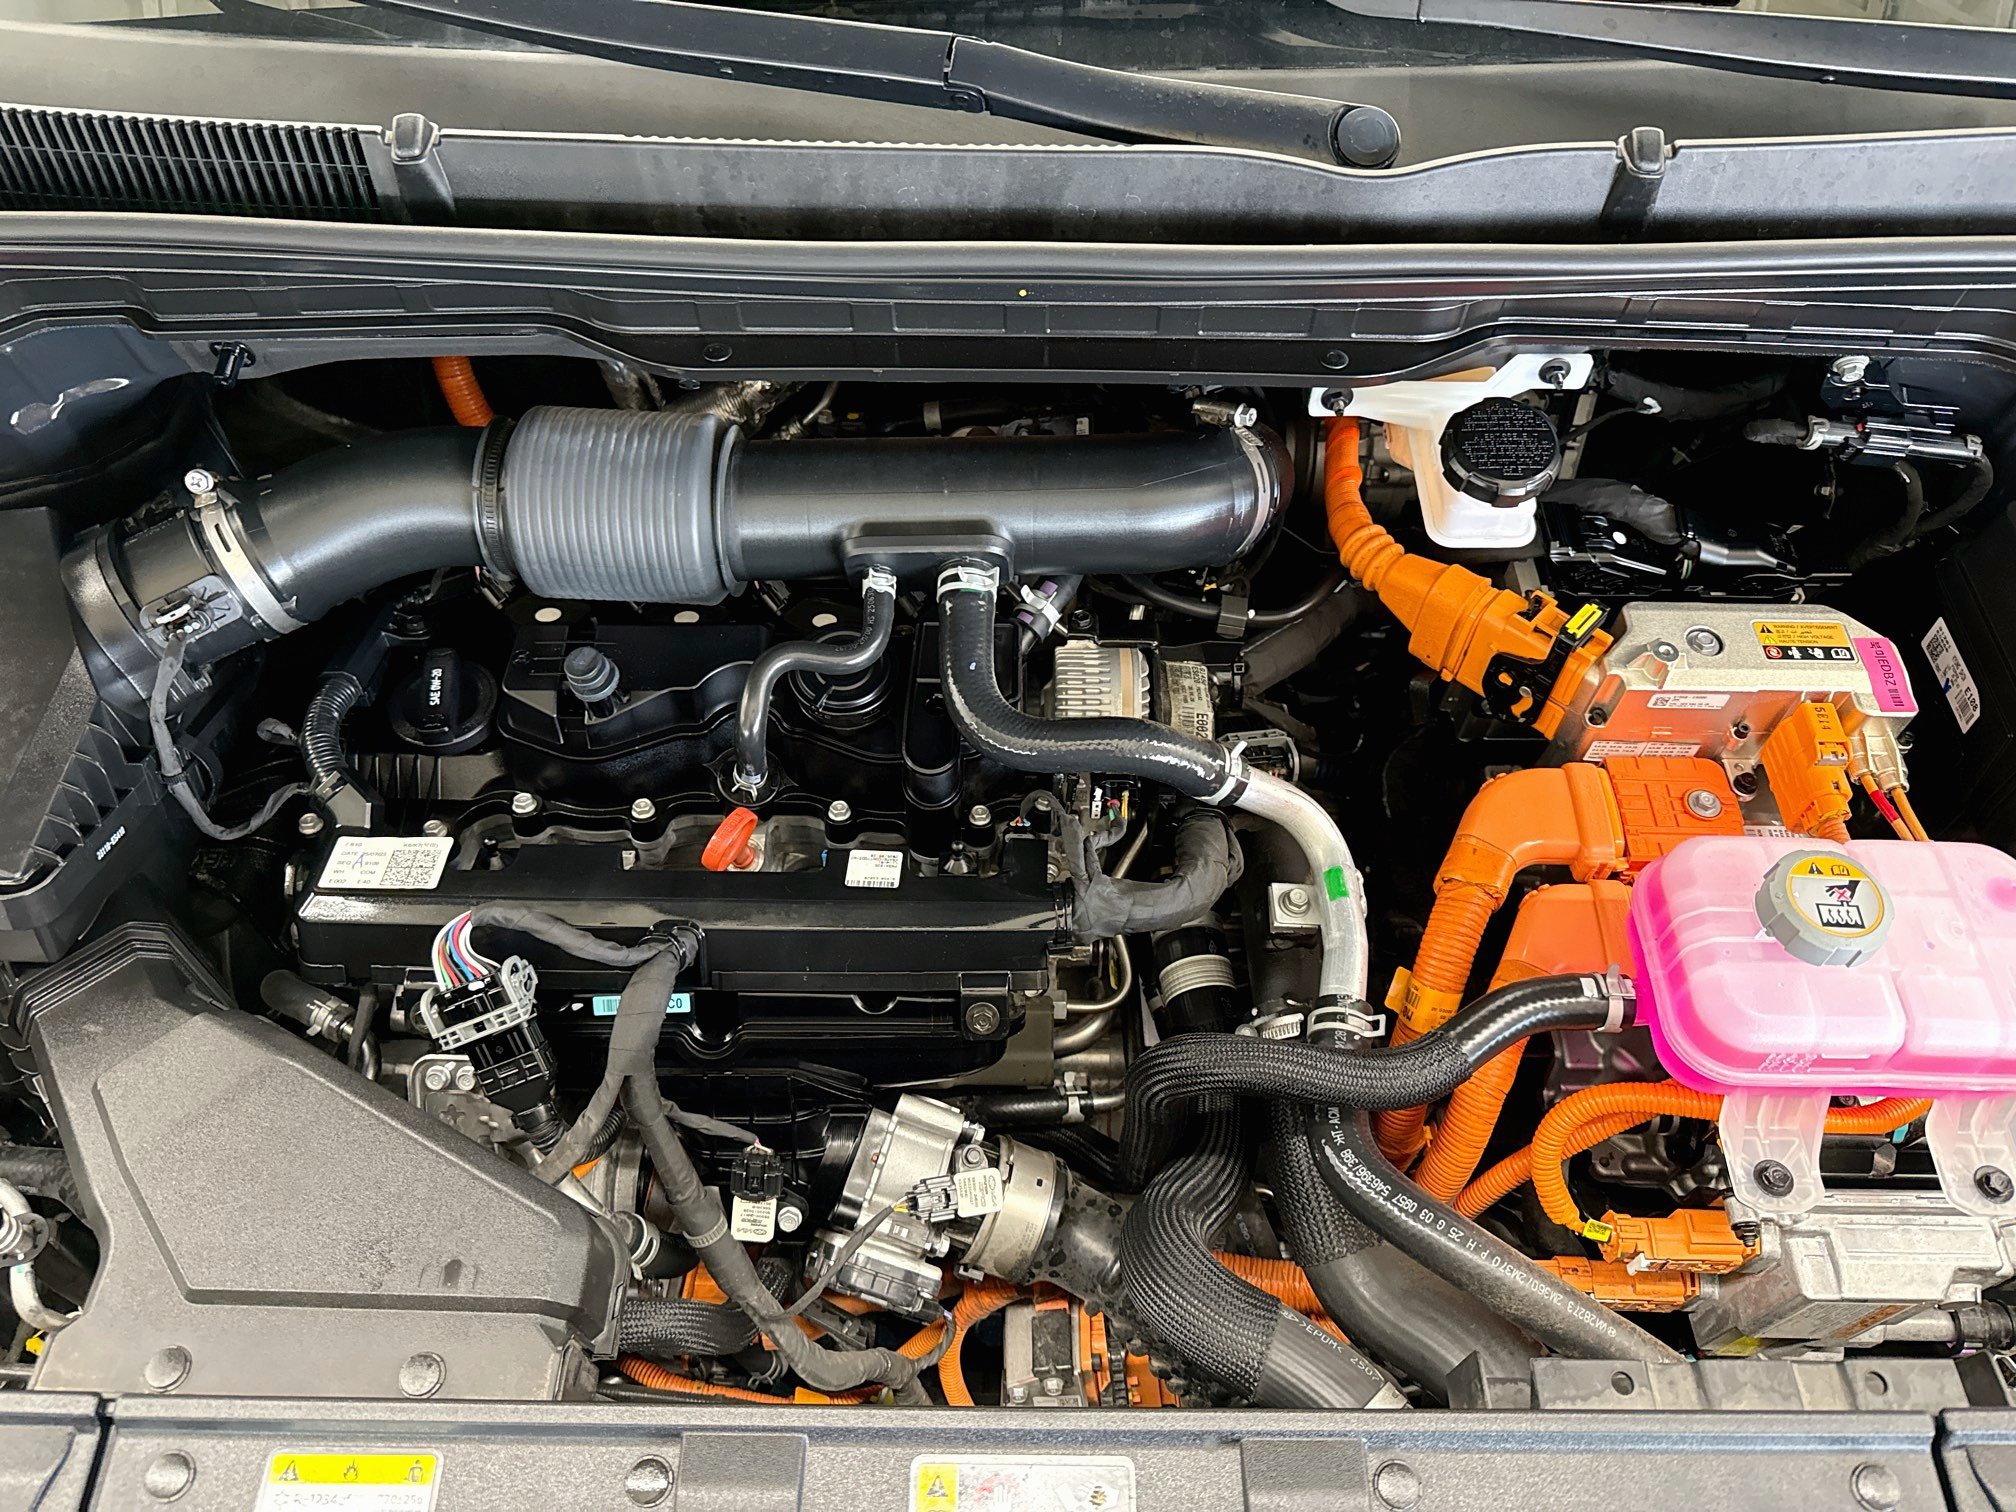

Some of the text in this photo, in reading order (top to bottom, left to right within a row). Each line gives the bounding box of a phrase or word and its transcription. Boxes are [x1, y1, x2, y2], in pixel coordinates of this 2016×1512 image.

[429, 668, 443, 706] SAE 0W-20
[1340, 1148, 1392, 1197] 546396/398
[1391, 1193, 1418, 1213] 0957
[1418, 1208, 1434, 1224] 03
[1436, 1219, 1446, 1231] G
[1447, 1226, 1465, 1242] 25
